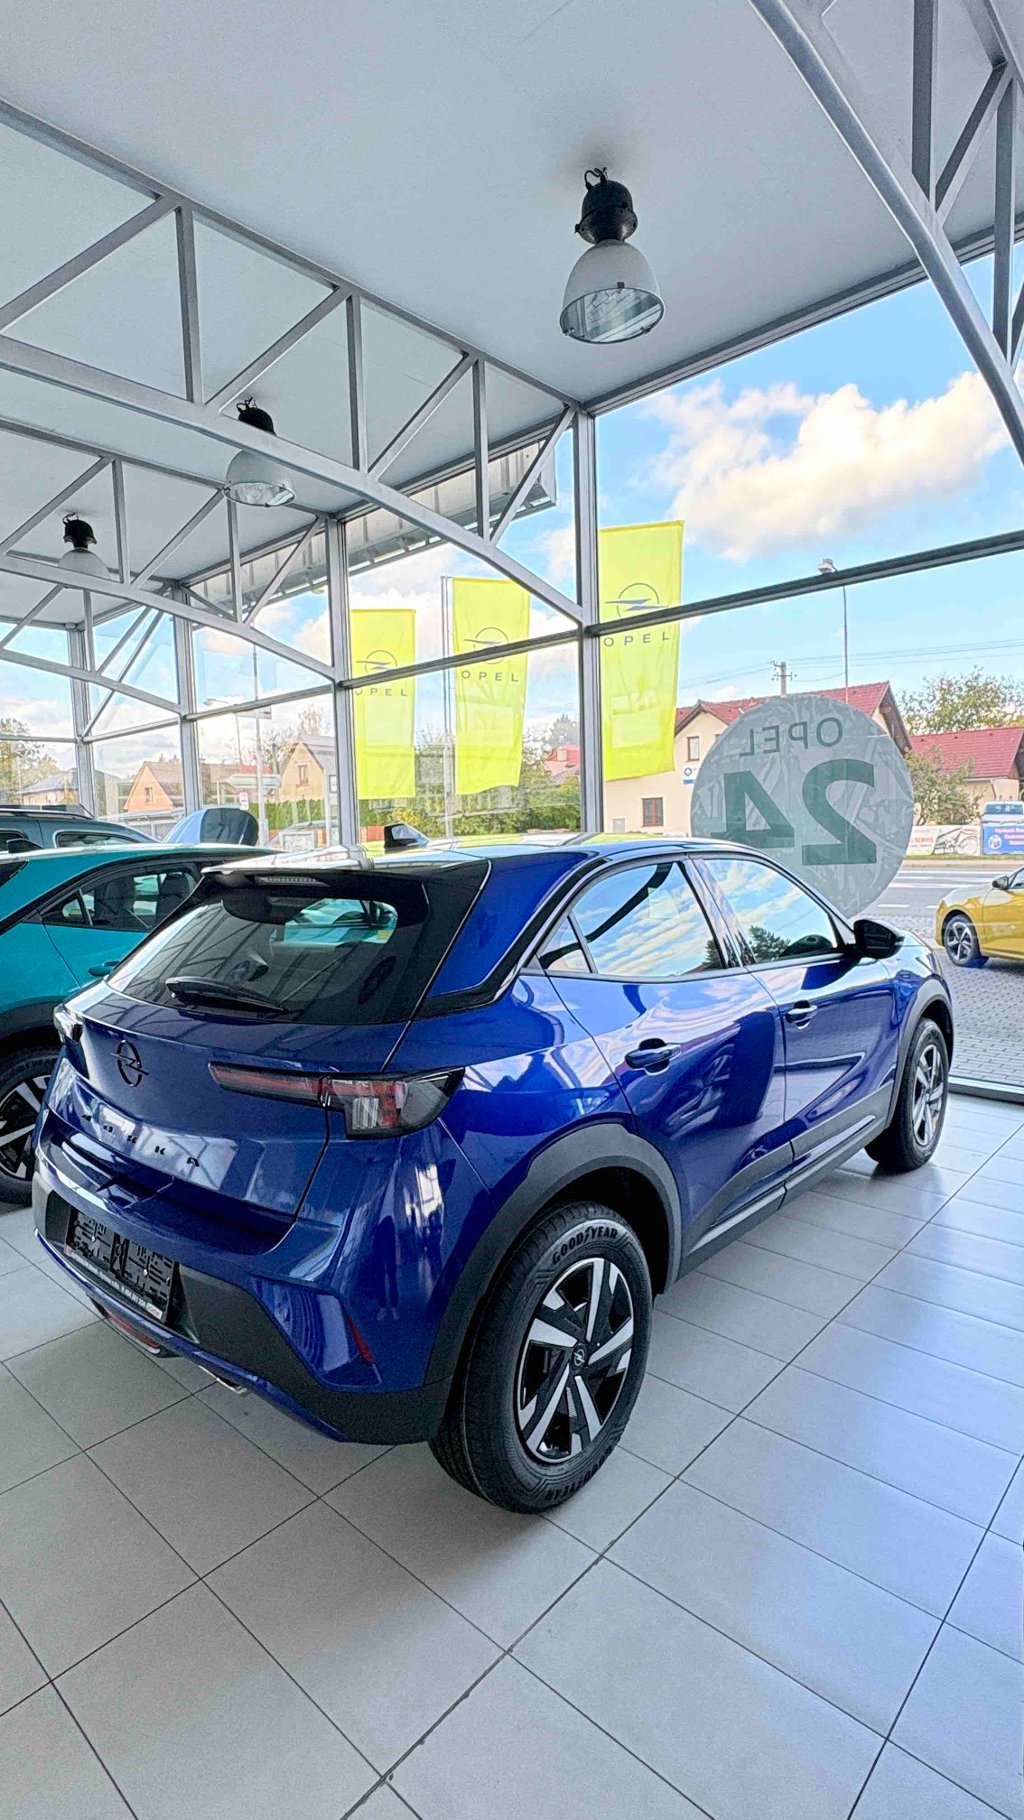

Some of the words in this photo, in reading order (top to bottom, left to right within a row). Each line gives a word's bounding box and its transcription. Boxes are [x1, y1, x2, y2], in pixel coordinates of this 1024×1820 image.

[603, 632, 671, 647] OPEL
[461, 670, 519, 682] OPEL
[354, 687, 408, 697] OPEL
[551, 1225, 618, 1265] GOODYEAR
